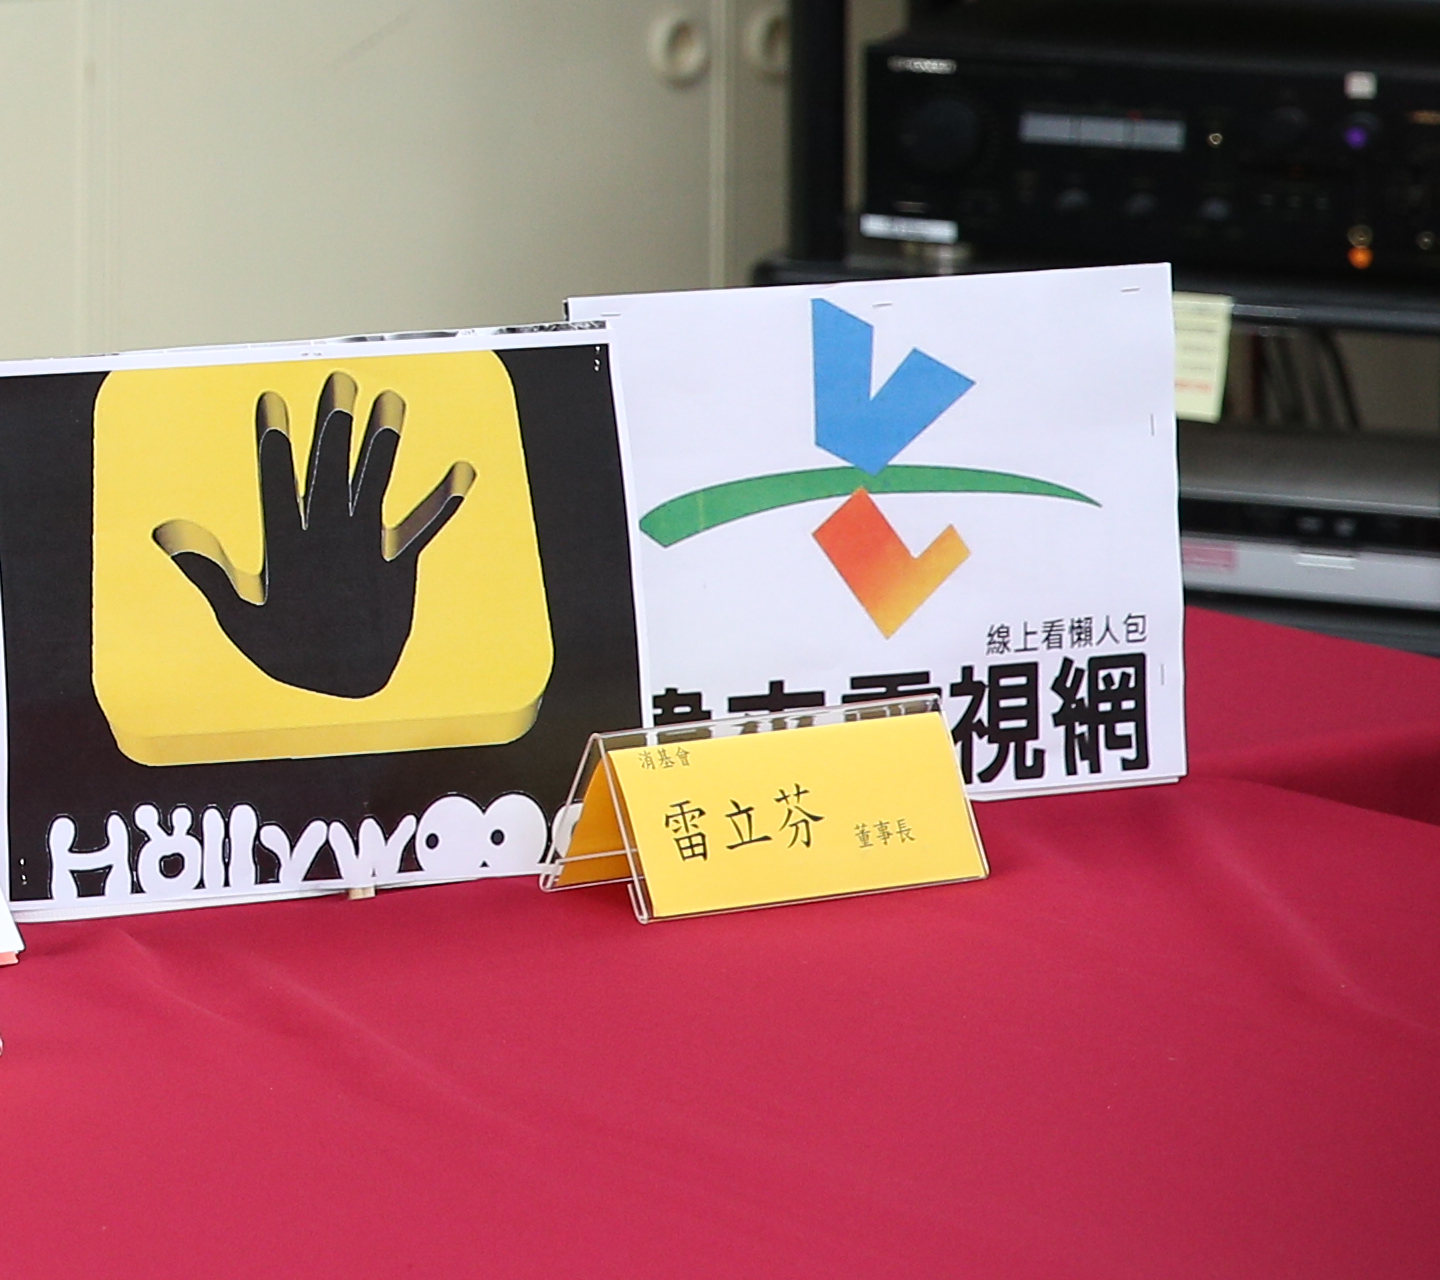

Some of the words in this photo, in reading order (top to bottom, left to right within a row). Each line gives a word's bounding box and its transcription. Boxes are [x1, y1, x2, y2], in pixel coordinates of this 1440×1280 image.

[985, 612, 1149, 656] 線上看懶人包
[637, 745, 690, 771] 消基會
[663, 783, 827, 862] 雷立芬
[853, 818, 916, 849] 董事長
